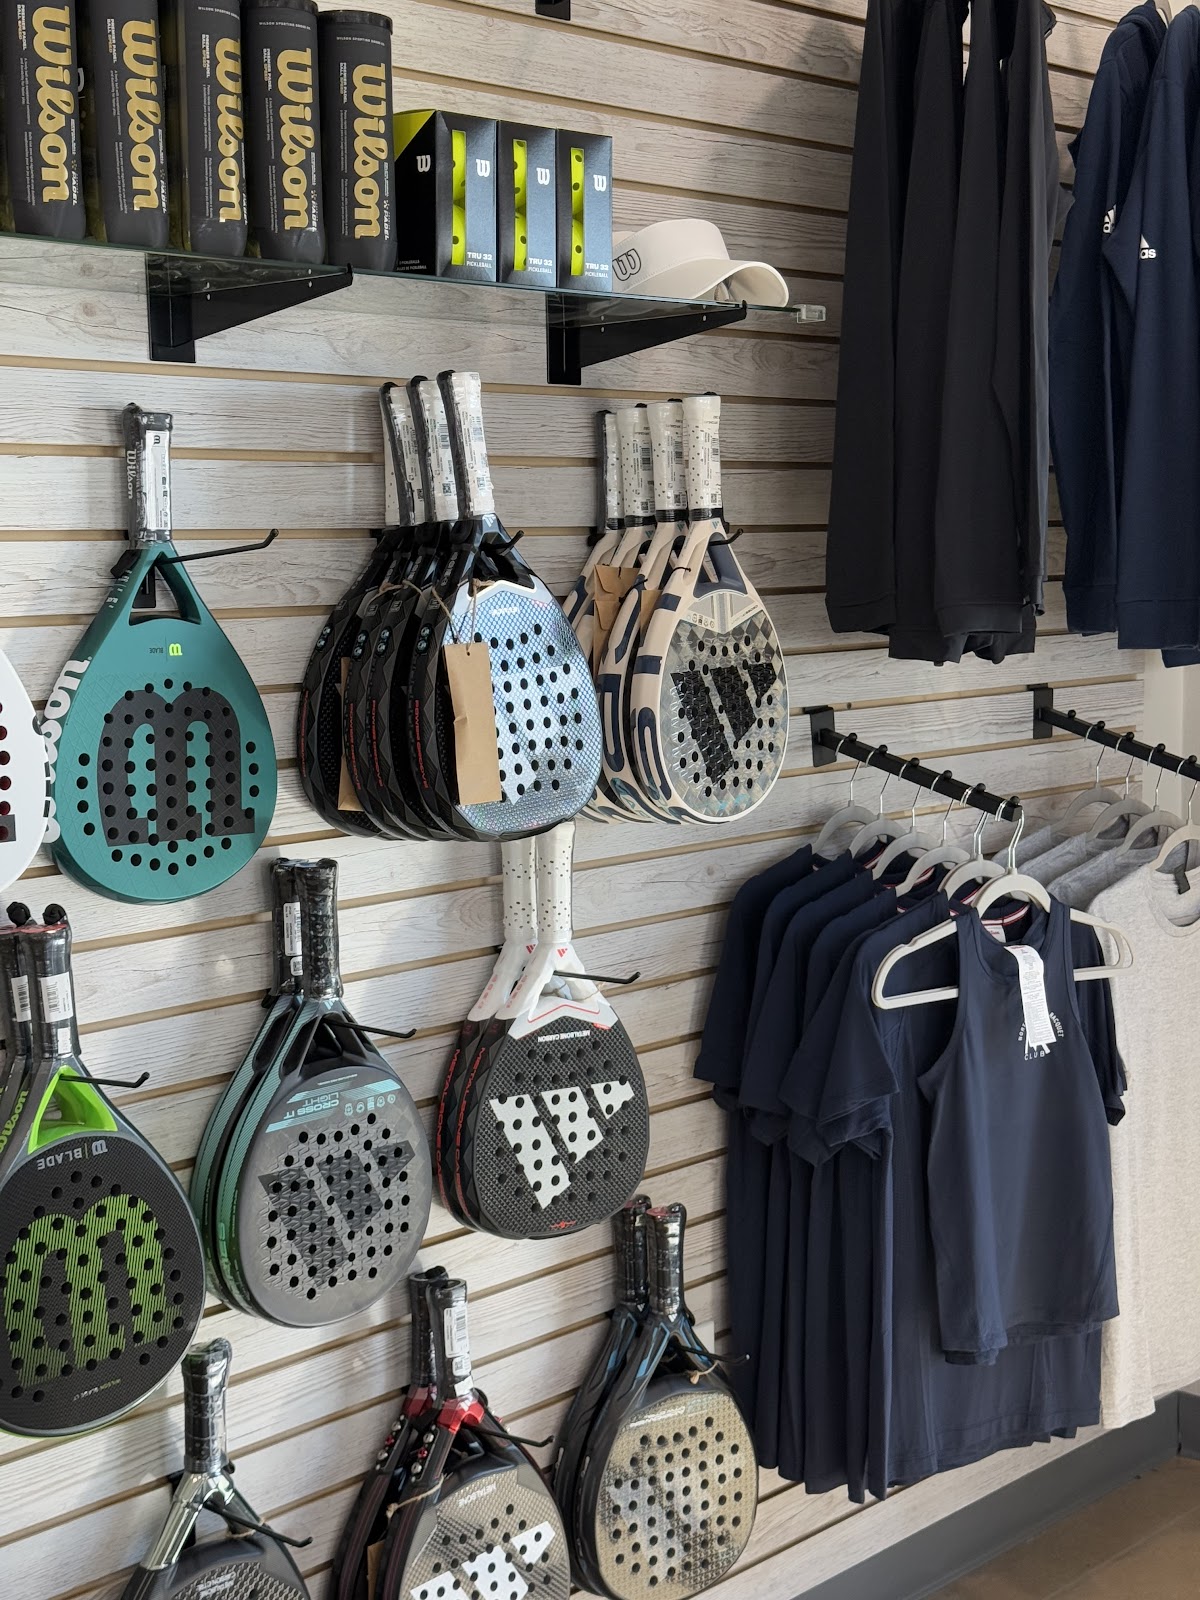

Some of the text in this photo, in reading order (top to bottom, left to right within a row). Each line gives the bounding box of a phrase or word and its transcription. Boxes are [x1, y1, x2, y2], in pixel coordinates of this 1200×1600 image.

[32, 6, 74, 203] Wilson
[122, 20, 160, 210] Wilson
[215, 38, 244, 222] Wilson
[276, 48, 314, 230] Wilson
[352, 63, 388, 239] Wilson
[466, 260, 492, 268] PICKLEBALL
[467, 252, 481, 260] TRU
[528, 258, 552, 267] TRU 32
[585, 262, 599, 270] TRU
[528, 266, 552, 274] PICKLEBALL
[126, 449, 136, 500] Wilson
[416, 742, 429, 788] GROOVE
[538, 1030, 590, 1042] METALBONE CARBON
[1050, 1012, 1064, 1038] RACQUET
[1024, 1050, 1045, 1060] CLUB
[302, 1092, 339, 1107] LIGHT
[456, 1047, 486, 1148] METALBONE
[284, 1099, 339, 1119] CROSS IT
[37, 1148, 82, 1170] BLADE
